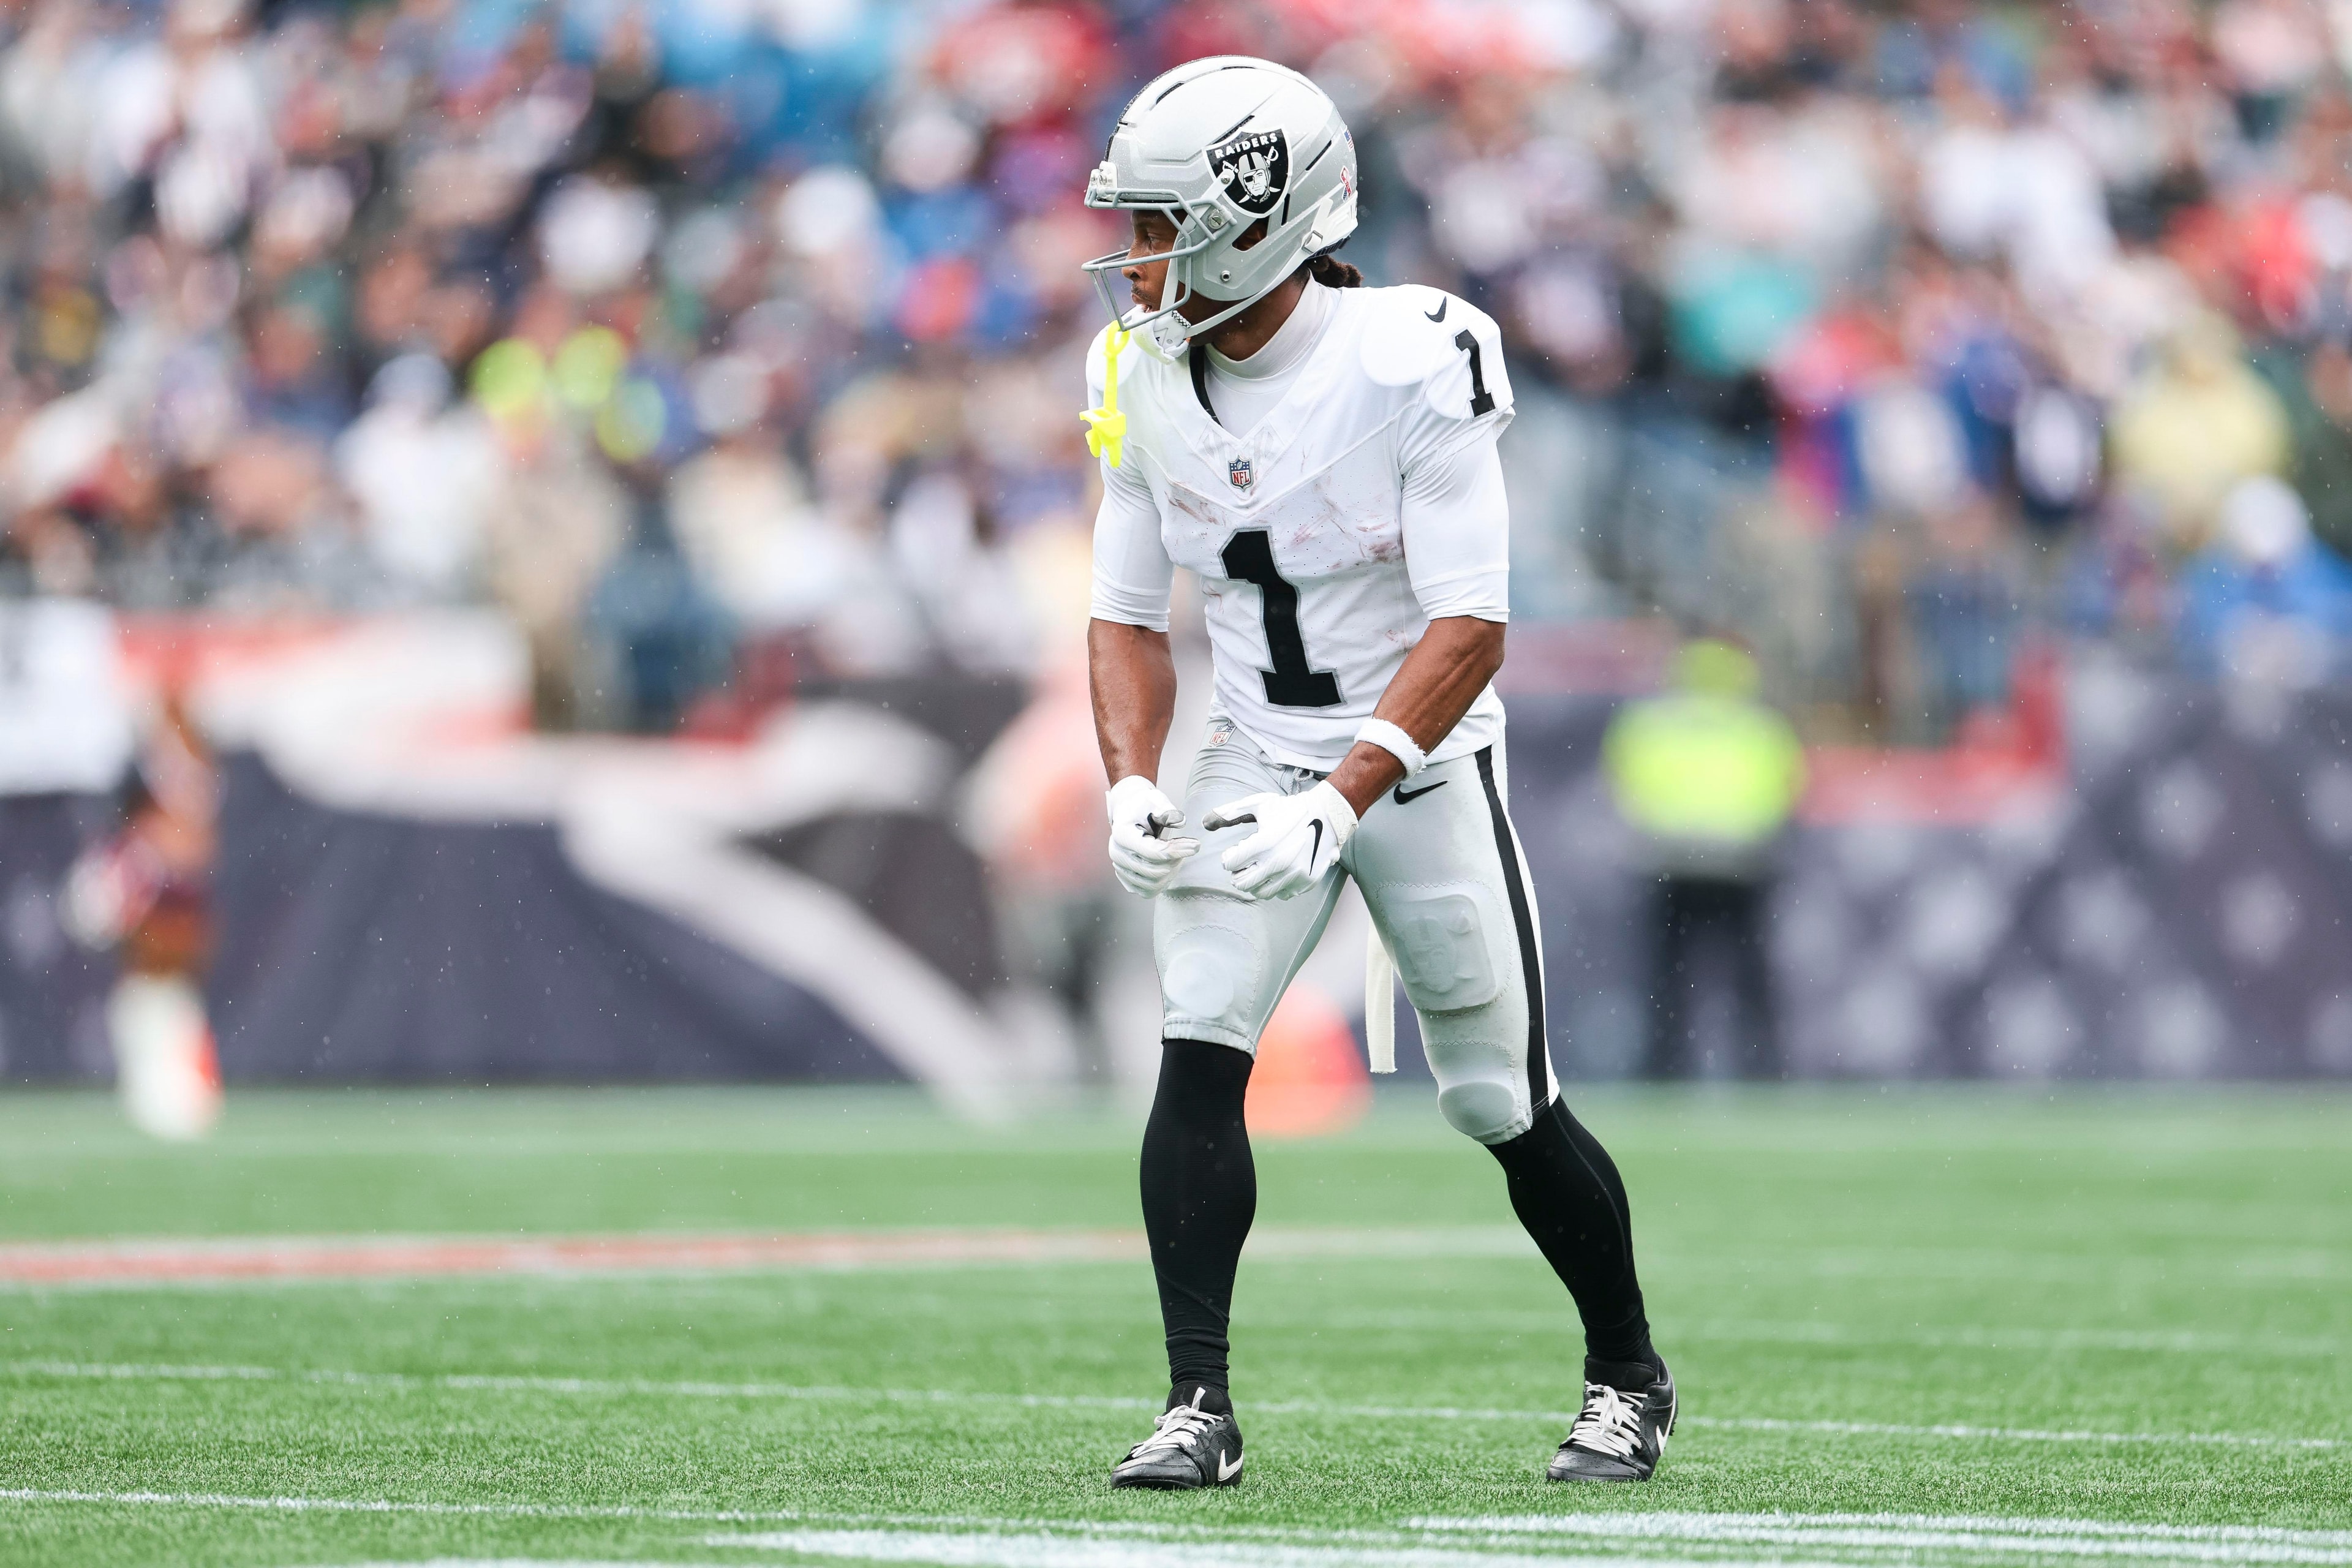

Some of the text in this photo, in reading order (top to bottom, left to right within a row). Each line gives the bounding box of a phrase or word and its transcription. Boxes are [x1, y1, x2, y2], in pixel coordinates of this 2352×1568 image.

[1214, 132, 1278, 159] RAIDERS
[1455, 329, 1496, 418] 1
[1232, 471, 1250, 484] NFL
[1221, 530, 1342, 707] 1
[1211, 733, 1227, 743] NFL
